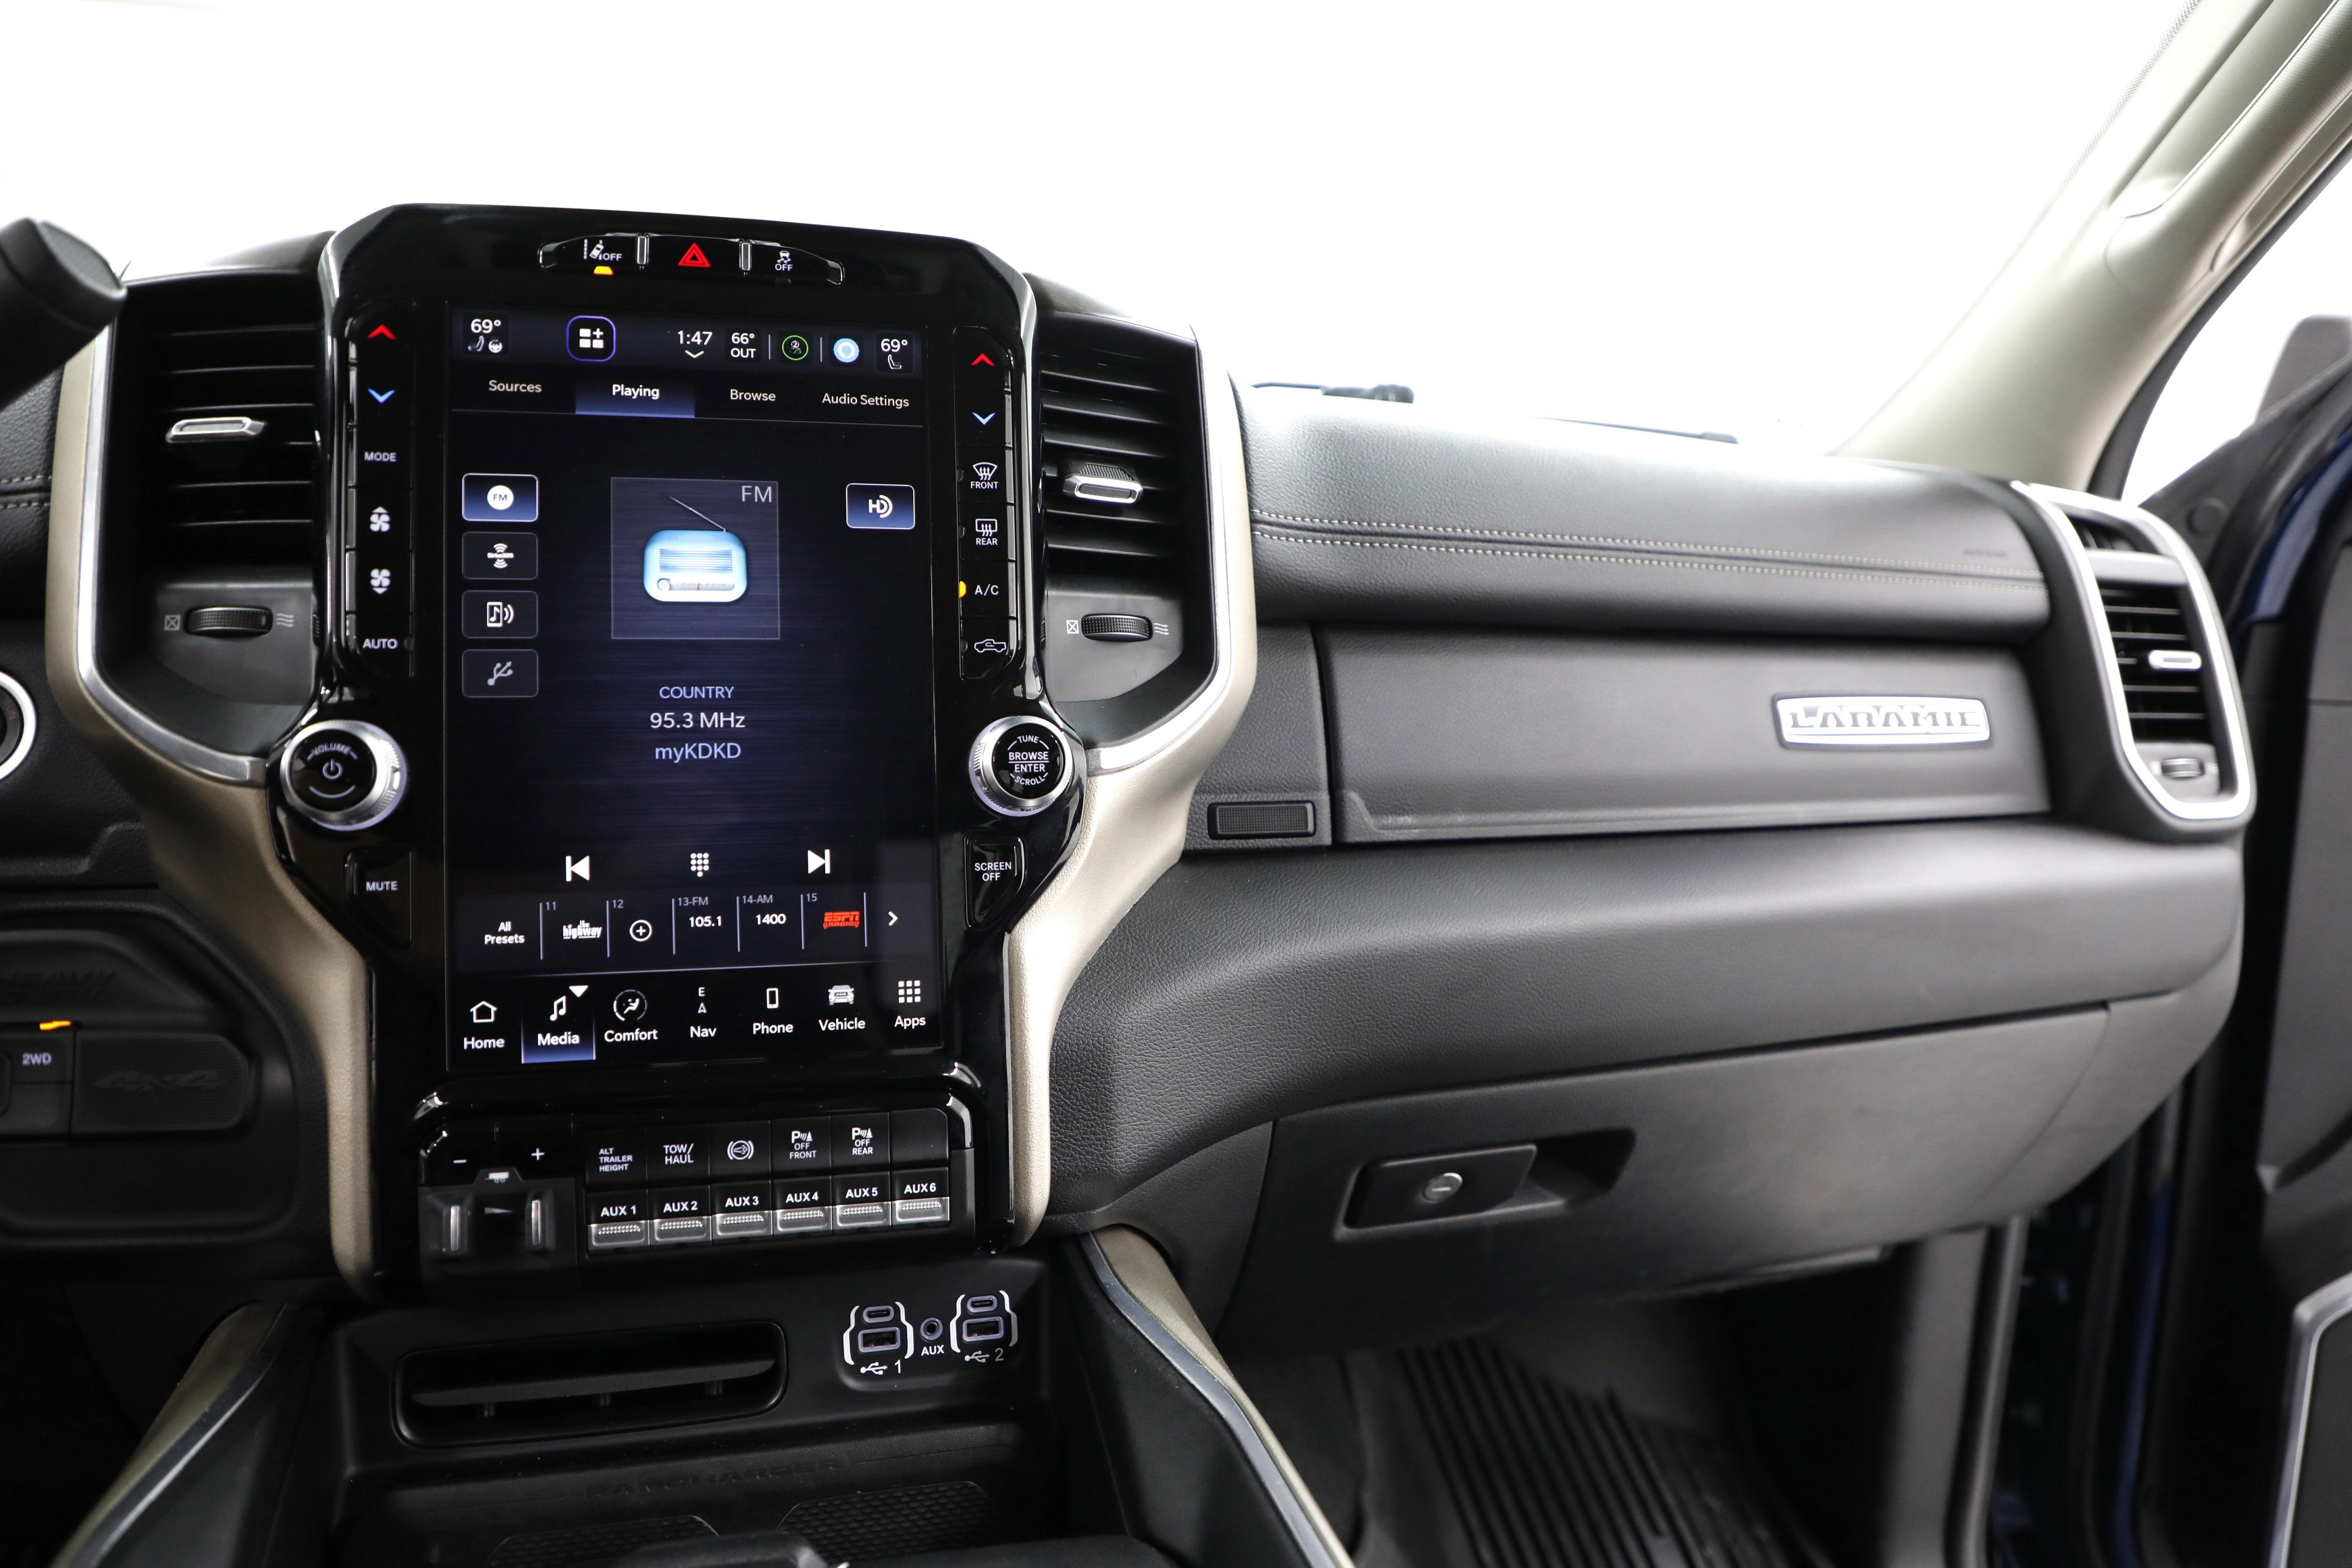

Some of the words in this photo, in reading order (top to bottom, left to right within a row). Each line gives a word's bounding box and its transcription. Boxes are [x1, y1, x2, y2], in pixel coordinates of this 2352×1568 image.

[603, 252, 622, 261] OFF
[471, 318, 501, 334] 69°
[677, 330, 713, 345] 1:47
[731, 332, 755, 344] 66°
[881, 339, 908, 352] 69°
[731, 347, 756, 358] OUT
[489, 380, 542, 393] Sources
[612, 384, 659, 400] Playing
[730, 389, 776, 401] Browse
[822, 393, 858, 405] Audio
[860, 394, 909, 409] Settings
[364, 452, 396, 462] MODE
[970, 481, 998, 489] FRONT
[493, 493, 508, 501] FM
[742, 486, 772, 502] FM
[975, 584, 999, 596] A/C
[362, 638, 398, 649] AUTO
[659, 686, 734, 699] COUNTRY
[650, 712, 693, 728] 95.3
[700, 712, 745, 728] MHz
[1017, 735, 1039, 743] TUNE
[312, 743, 352, 755] VOLUME
[655, 742, 741, 763] myKDKD
[1009, 751, 1049, 760] BROWSE
[1014, 763, 1045, 773] ENTER
[1015, 776, 1045, 785] SCROLL
[974, 862, 1011, 871] SCREEN
[982, 872, 1000, 882] OFF
[366, 881, 398, 891] MUTE
[678, 896, 708, 906] 13-FM
[742, 894, 773, 904] 14-AM
[806, 893, 817, 902] 15
[546, 901, 556, 911] 11
[612, 899, 624, 908] 12
[689, 915, 722, 927] 105.1
[756, 913, 786, 925] 1400
[824, 911, 860, 922] ESPN
[498, 921, 512, 932] All
[563, 925, 602, 939] highway
[484, 933, 525, 944] Presets
[698, 987, 705, 997] E
[818, 1017, 866, 1031] Vehicle
[894, 1015, 926, 1029] Apps
[690, 1025, 717, 1038] Nav
[753, 1022, 793, 1035] Phone
[537, 1031, 580, 1046] Media
[604, 1028, 658, 1042] Comfort
[463, 1037, 505, 1049] Home
[22, 1053, 51, 1065] 2WD
[663, 1143, 694, 1154] TOW/
[852, 1147, 873, 1155] REAR
[599, 1155, 633, 1163] TRAILER
[665, 1154, 694, 1165] HAUL
[789, 1150, 817, 1159] FRONT
[599, 1163, 629, 1172] HEIGHT
[845, 1187, 870, 1198] AUX
[871, 1187, 878, 1197] 5
[904, 1183, 928, 1194] AUX
[929, 1183, 936, 1192] 6
[725, 1196, 750, 1207] AUX
[752, 1196, 759, 1205] 3
[785, 1192, 810, 1203] AUX
[811, 1192, 819, 1201] 4
[600, 1205, 629, 1217] AUX
[630, 1205, 636, 1215] 1
[663, 1201, 689, 1213] AUX
[691, 1200, 698, 1211] 2
[921, 1345, 944, 1356] AUX
[995, 1348, 1004, 1361] 2
[895, 1359, 901, 1374] 1
